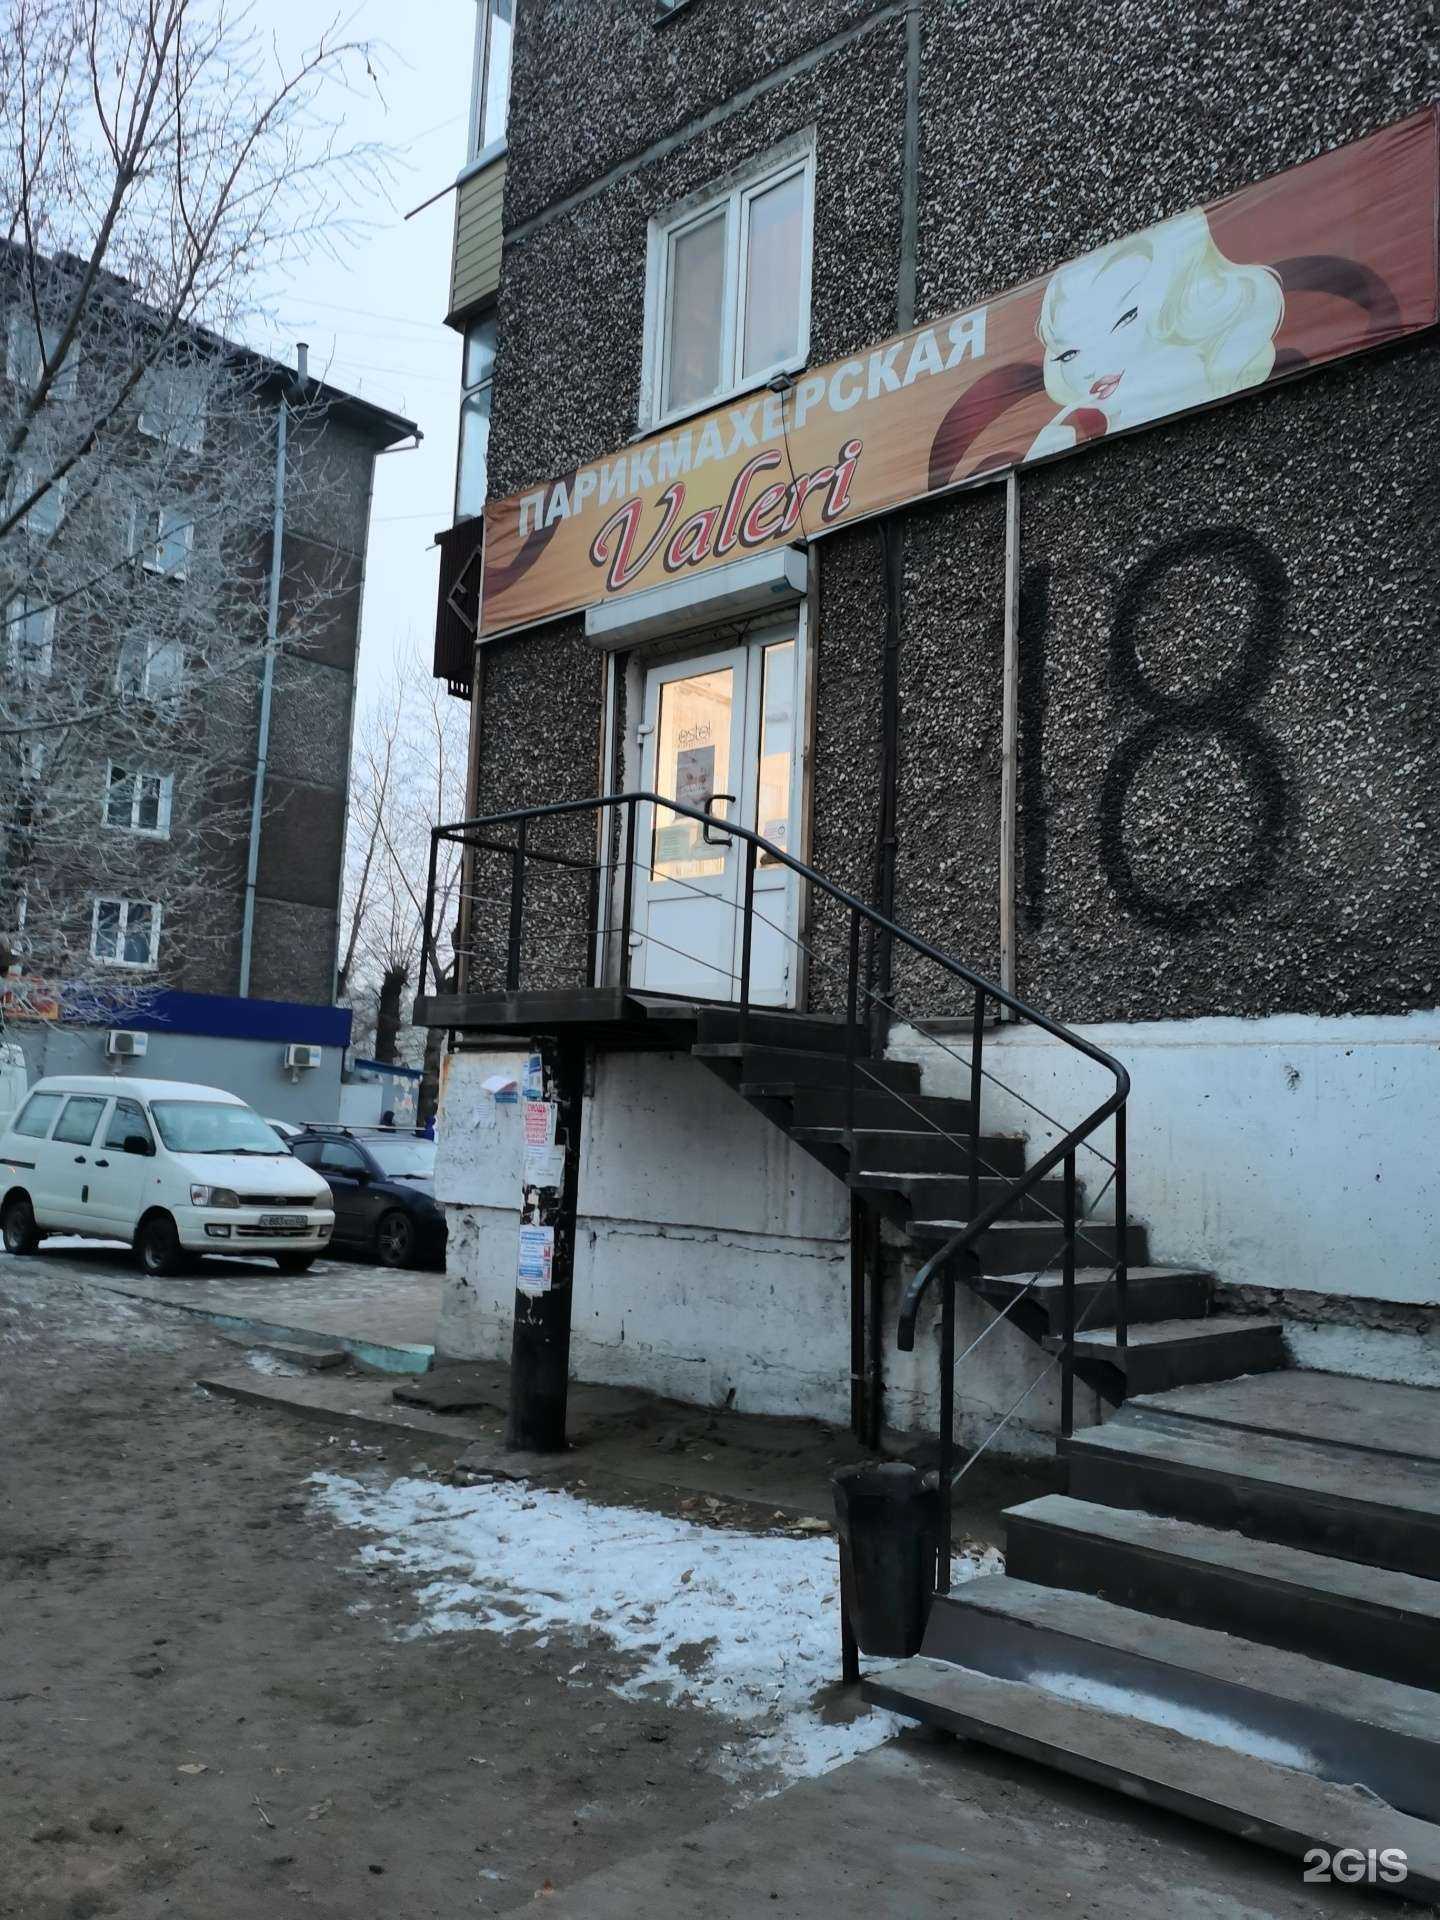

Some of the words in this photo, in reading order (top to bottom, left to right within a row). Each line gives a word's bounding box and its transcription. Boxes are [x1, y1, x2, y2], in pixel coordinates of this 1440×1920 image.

[518, 306, 988, 537] ПАРИКМАХЕРСКАЯ
[590, 438, 863, 592] Valeri
[1018, 525, 1291, 934] 18
